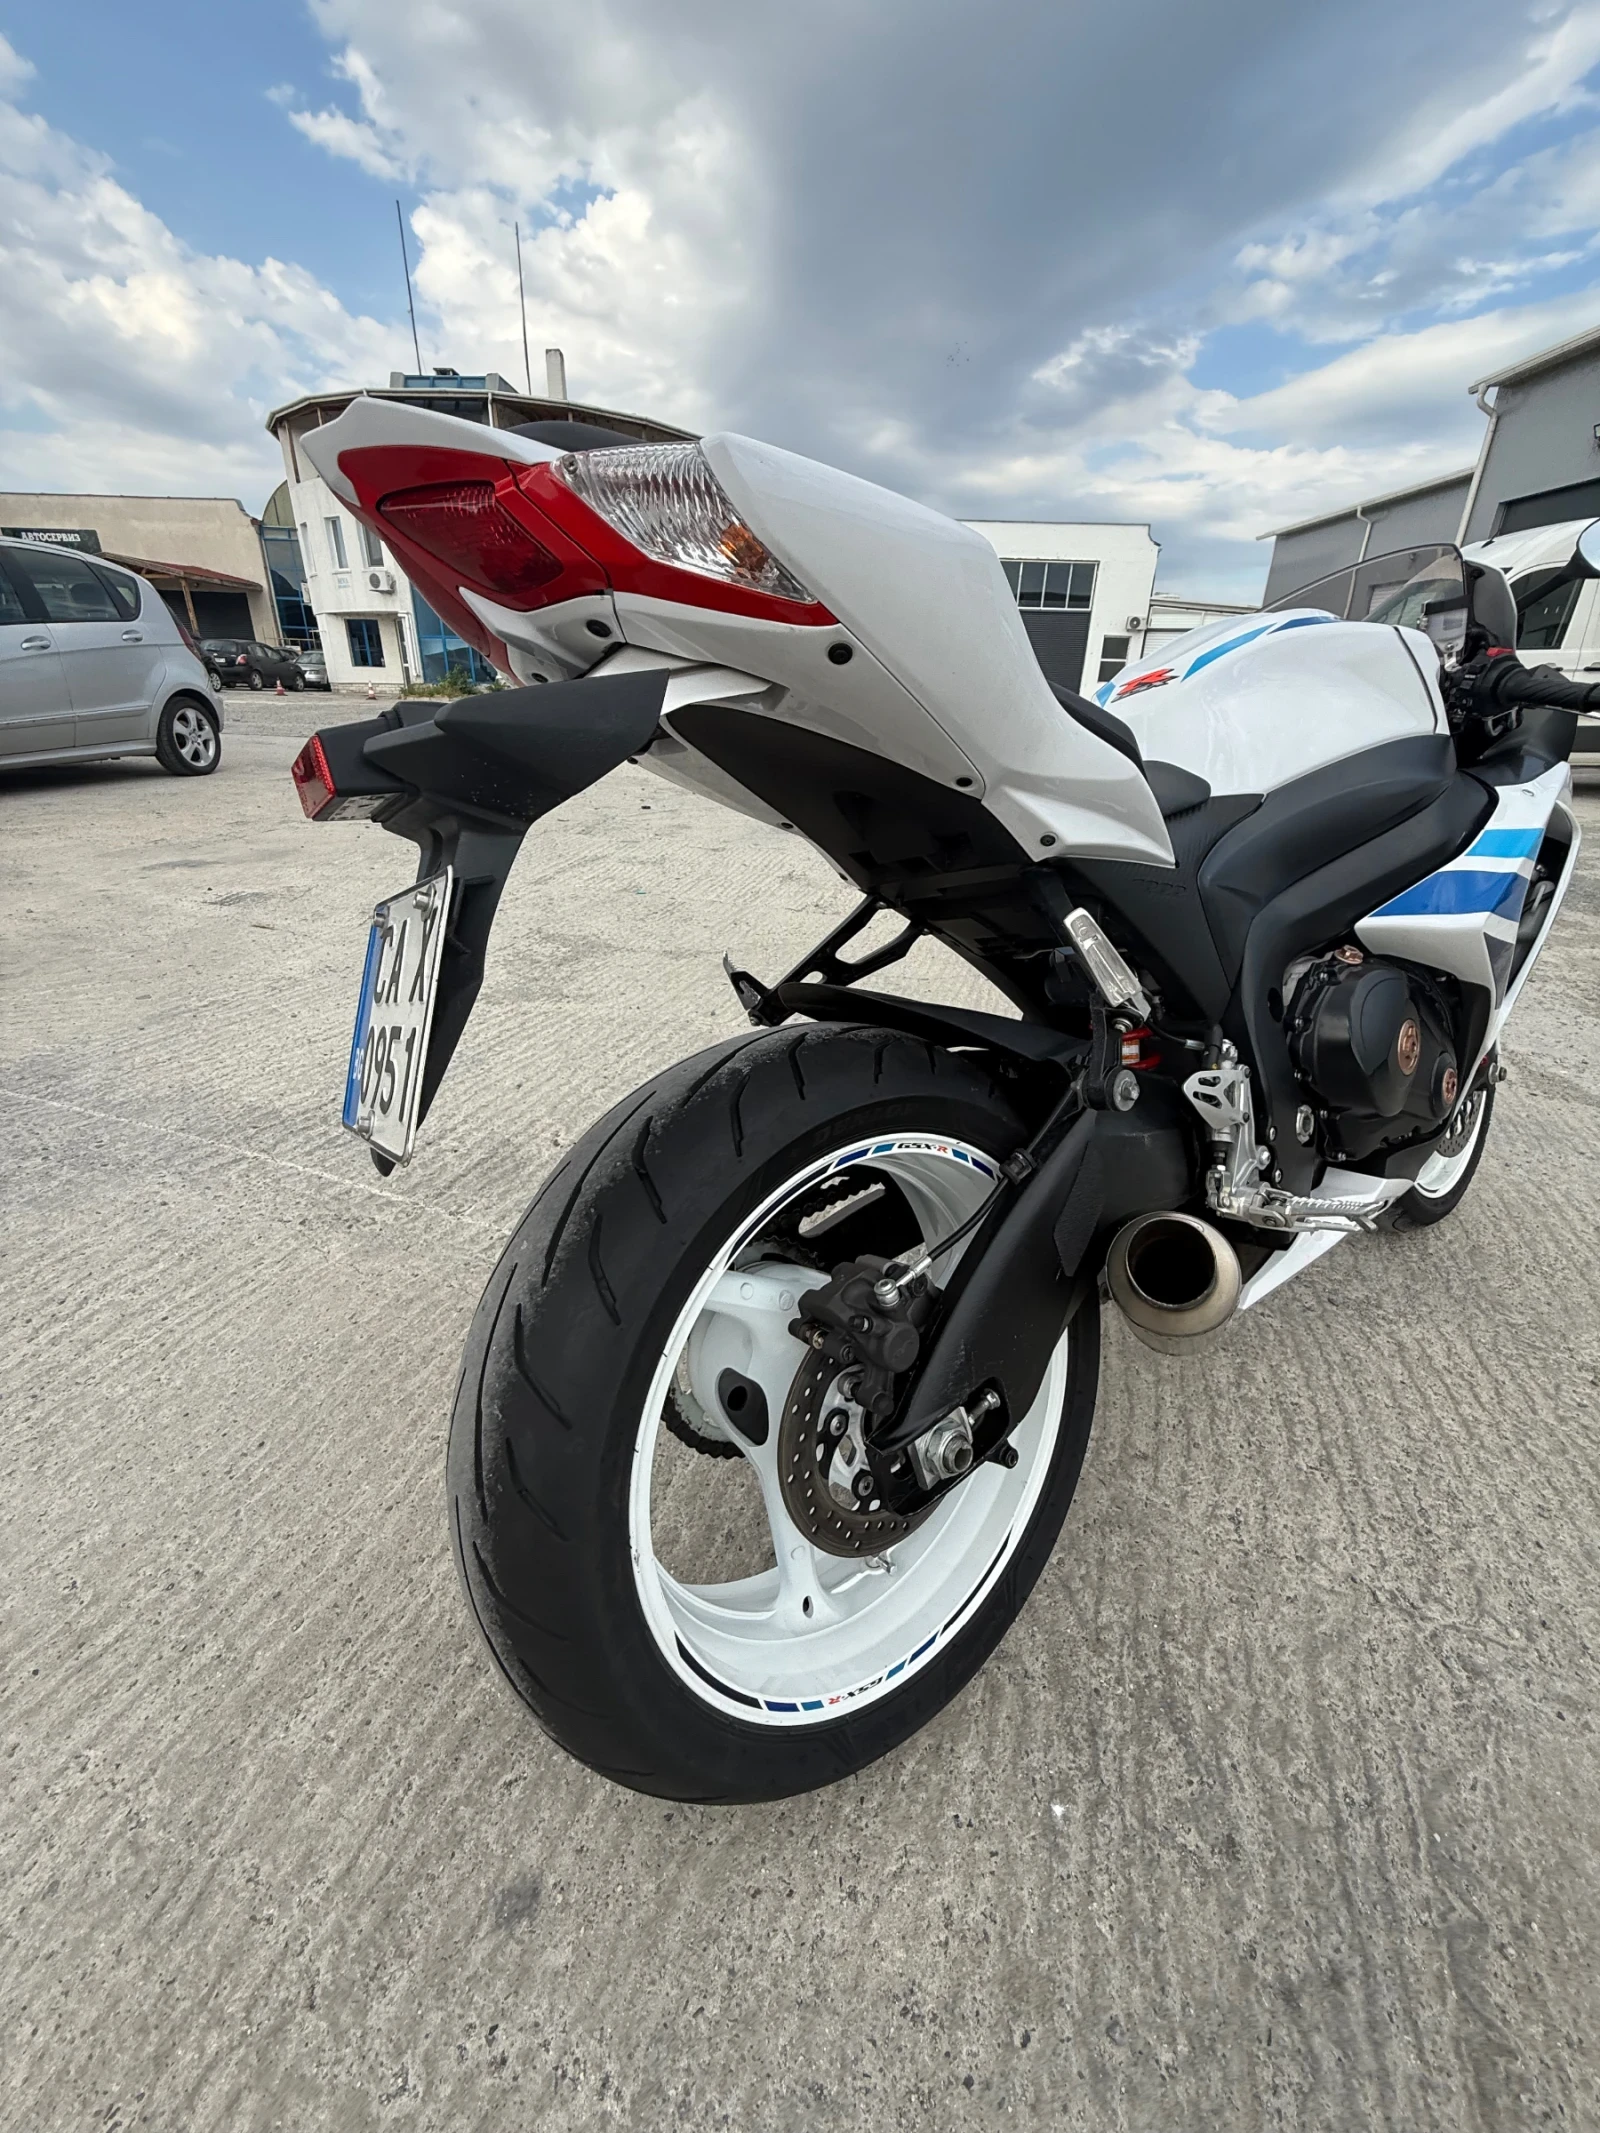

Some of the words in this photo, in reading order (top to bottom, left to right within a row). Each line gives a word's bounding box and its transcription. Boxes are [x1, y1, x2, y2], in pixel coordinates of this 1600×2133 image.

[21, 531, 81, 542] АВТОСЕРВИЗ
[373, 917, 408, 1004] CA
[360, 1024, 416, 1122] 0951
